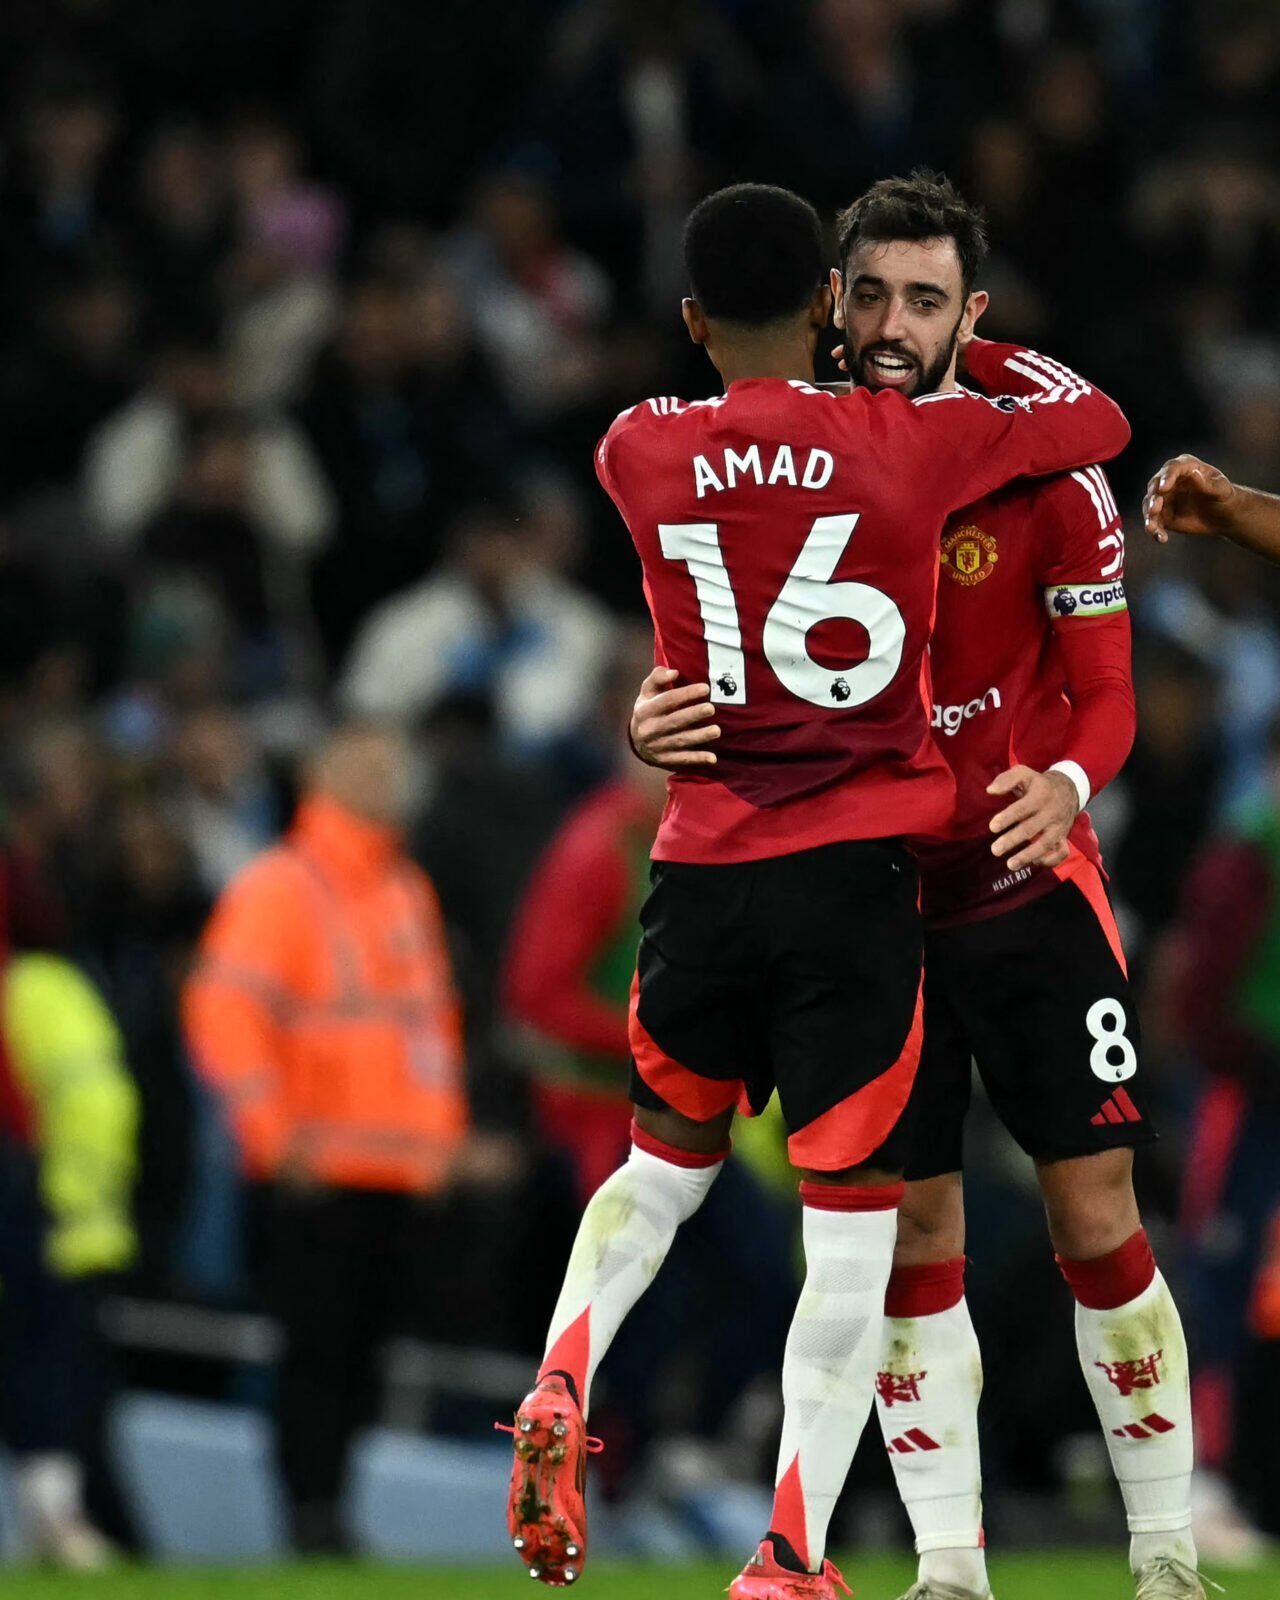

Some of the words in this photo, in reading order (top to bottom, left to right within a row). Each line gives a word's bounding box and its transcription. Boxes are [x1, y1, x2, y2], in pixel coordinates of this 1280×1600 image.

[692, 445, 834, 498] AMAD
[944, 529, 993, 550] MANCHESTER
[952, 571, 987, 583] UNITED
[657, 513, 906, 709] 16
[1079, 585, 1125, 607] Capta
[1085, 997, 1138, 1083] 8
